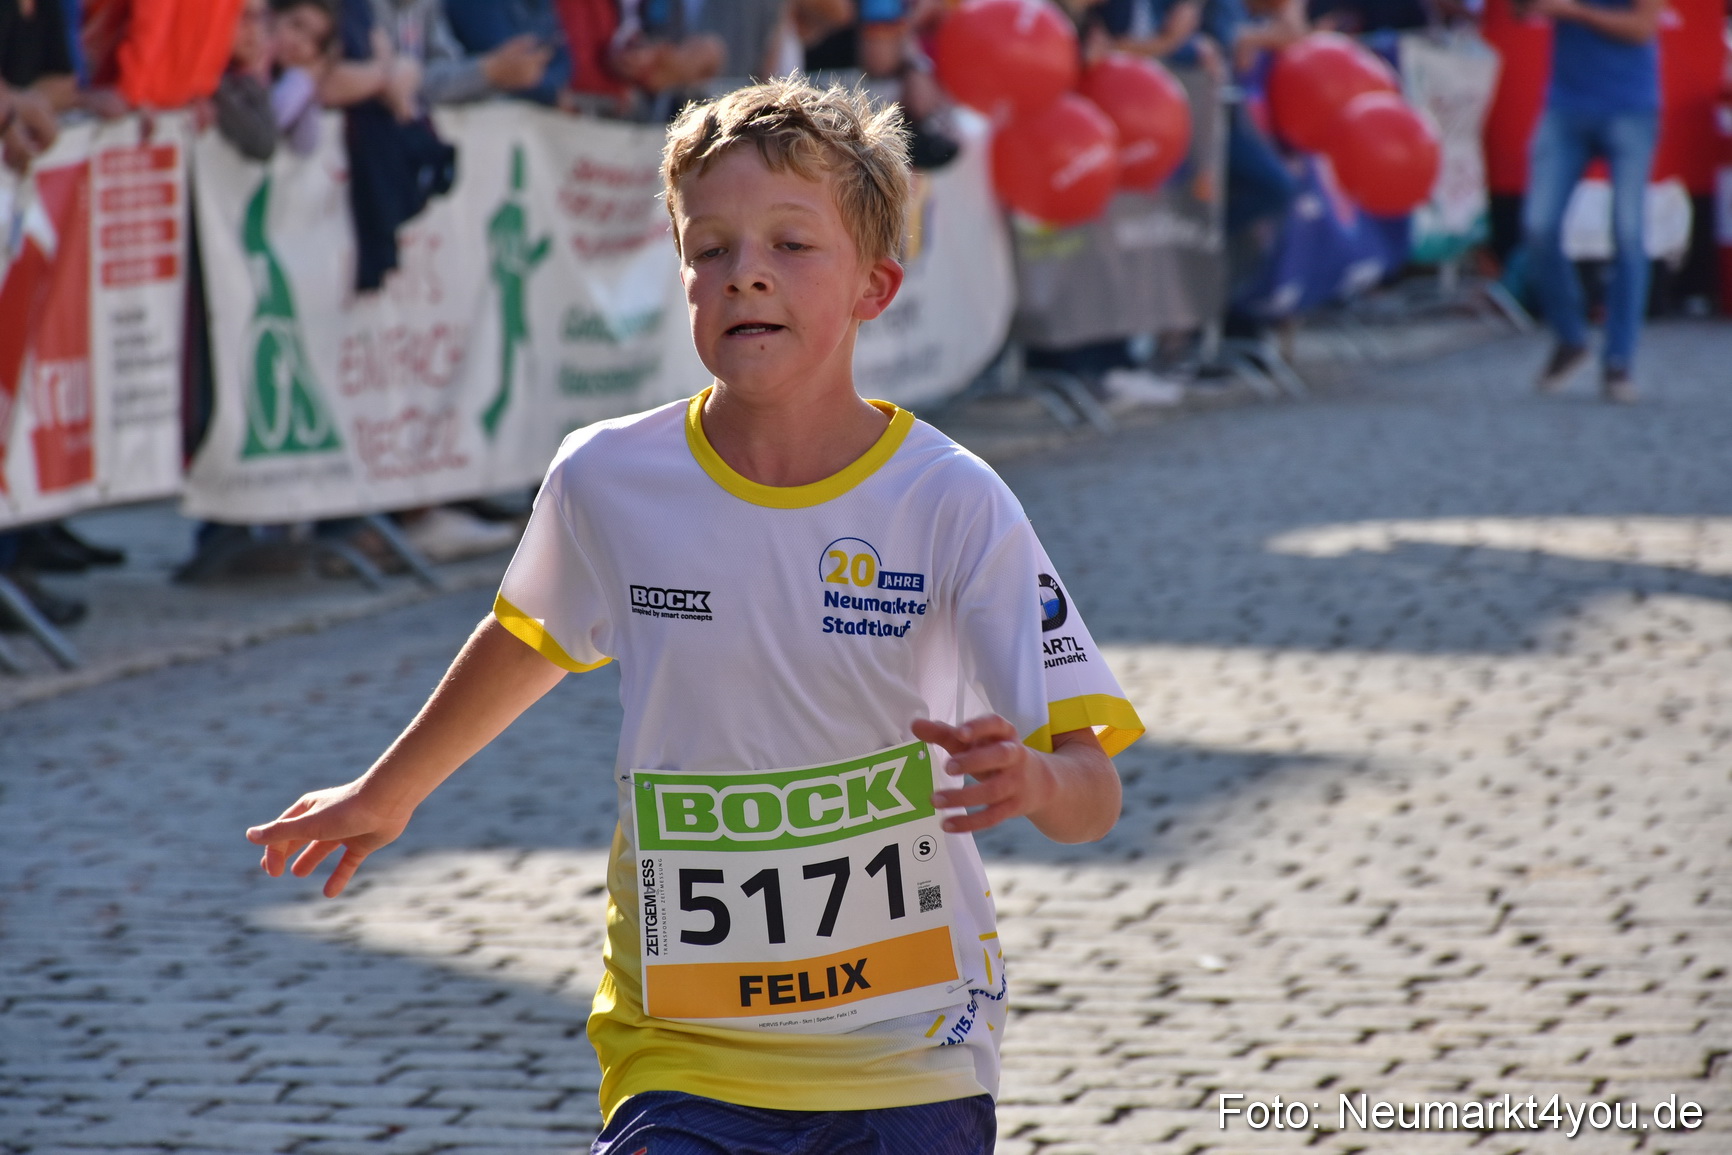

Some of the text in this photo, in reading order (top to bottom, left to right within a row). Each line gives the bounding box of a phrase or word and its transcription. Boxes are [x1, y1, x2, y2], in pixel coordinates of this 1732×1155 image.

[826, 550, 920, 588] 20 JAHRE
[630, 585, 712, 613] BOCK
[824, 590, 930, 615] Neumarkte
[653, 610, 660, 618] by
[681, 613, 712, 621] concepts
[822, 616, 911, 638] Stadtlauf
[1043, 636, 1084, 656] ARTL
[656, 757, 914, 841] BOCK
[919, 841, 931, 855] S
[658, 858, 666, 903] ZEITMESSUNG
[679, 843, 906, 946] 5171
[739, 958, 872, 1007] FELIX
